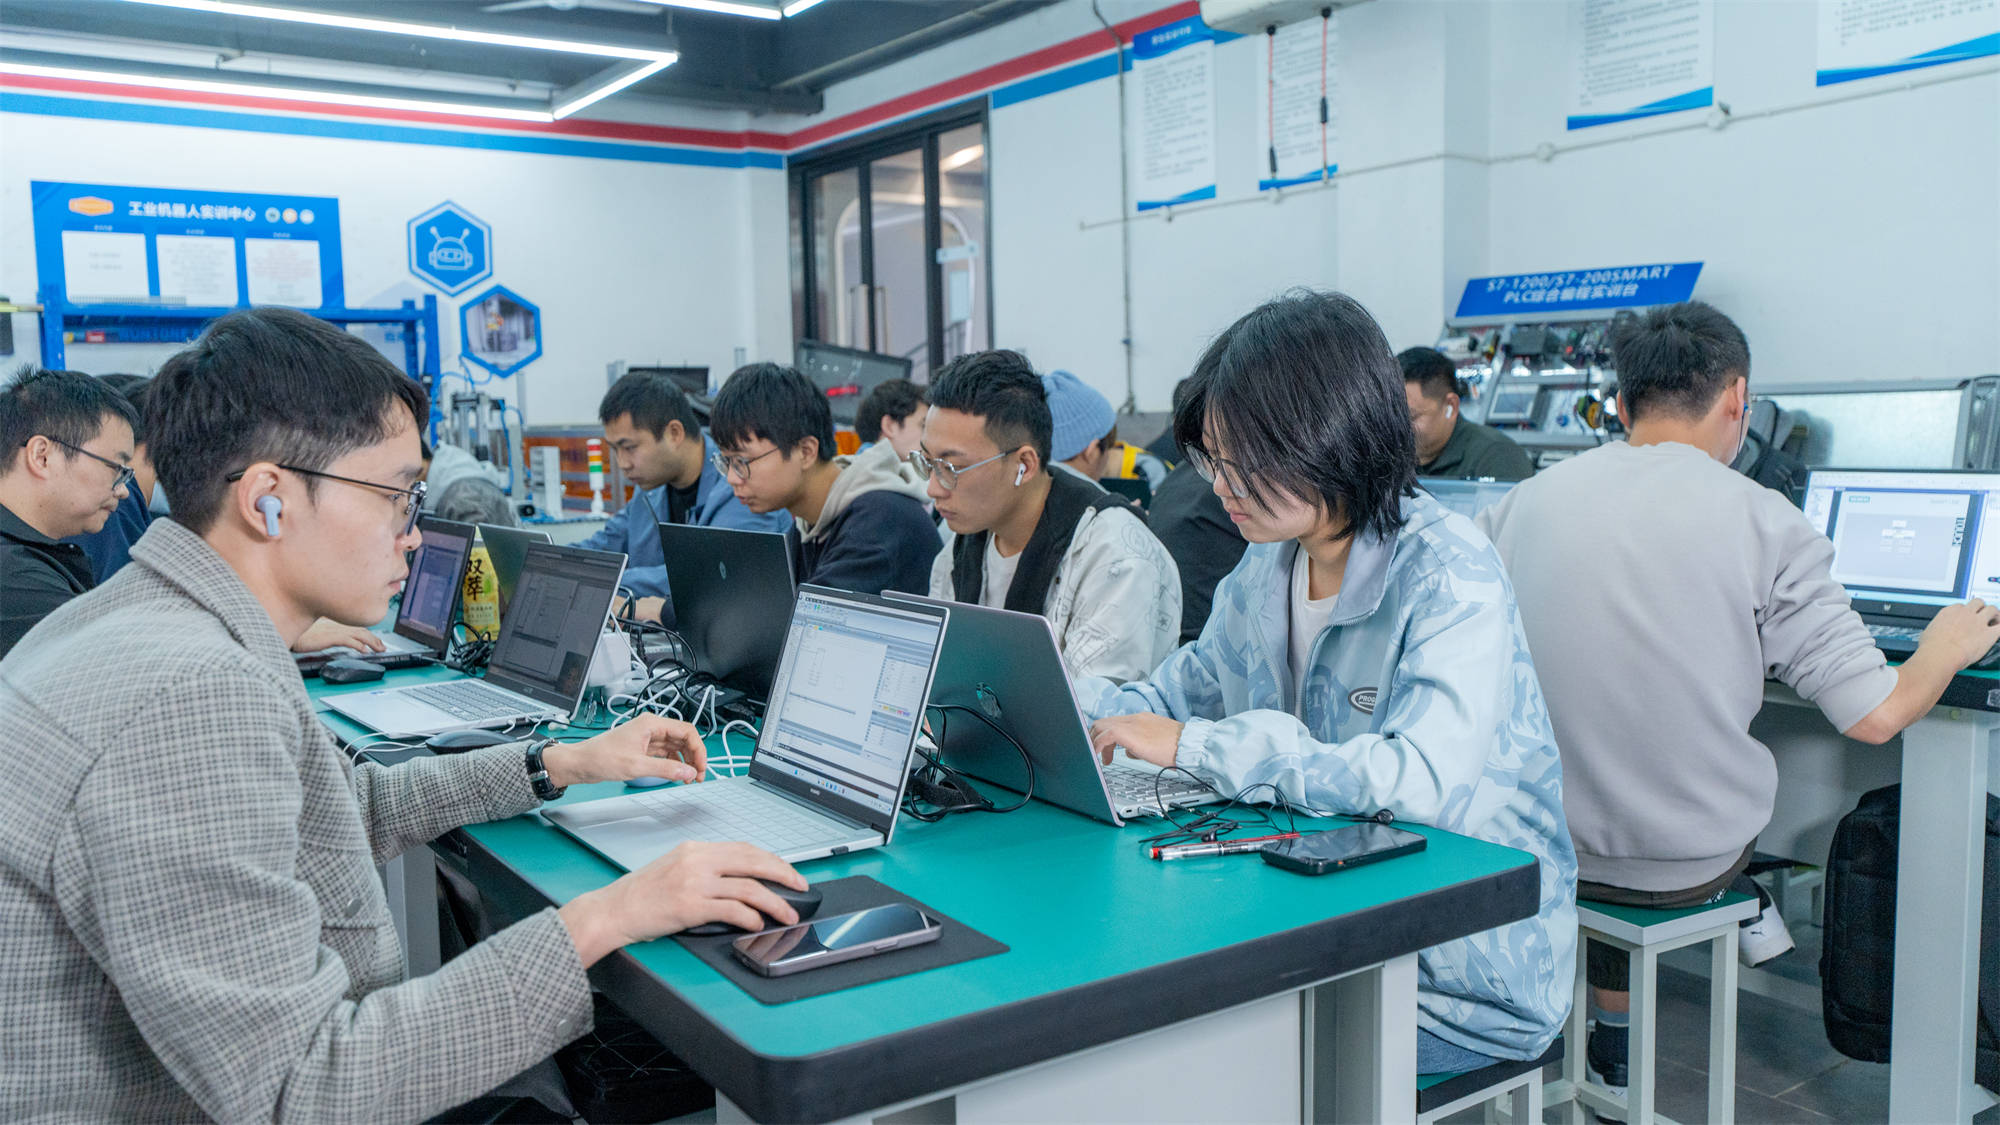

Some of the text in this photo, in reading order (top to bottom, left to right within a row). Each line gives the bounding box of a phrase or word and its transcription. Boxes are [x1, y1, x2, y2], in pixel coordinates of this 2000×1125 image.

[128, 200, 257, 222] 工业机器人实训中心
[1503, 283, 1640, 304] PLC综合编程实训台
